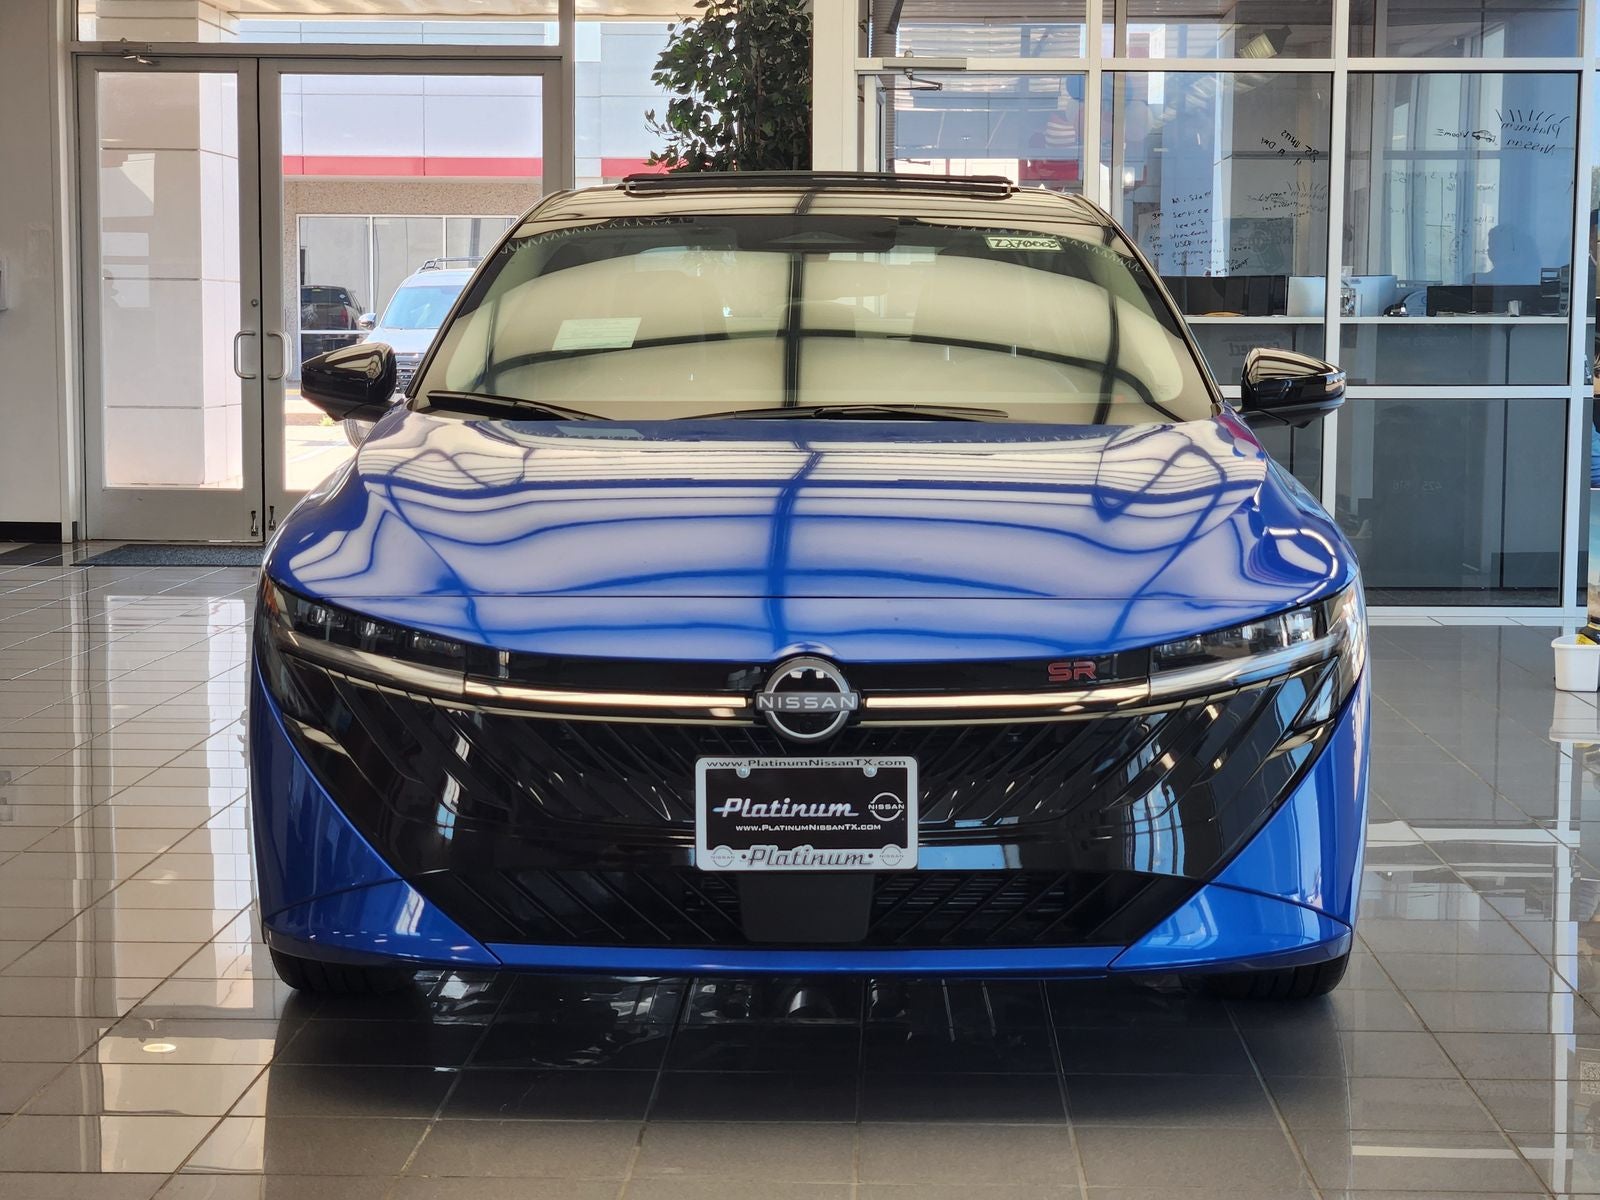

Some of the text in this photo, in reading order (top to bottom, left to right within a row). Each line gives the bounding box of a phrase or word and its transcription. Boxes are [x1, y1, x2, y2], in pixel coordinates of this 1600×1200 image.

[1048, 661, 1097, 681] SR
[758, 696, 856, 709] NISSAN
[706, 758, 906, 768] www.PlatinumNissanTX.com
[713, 798, 859, 818] Platinum
